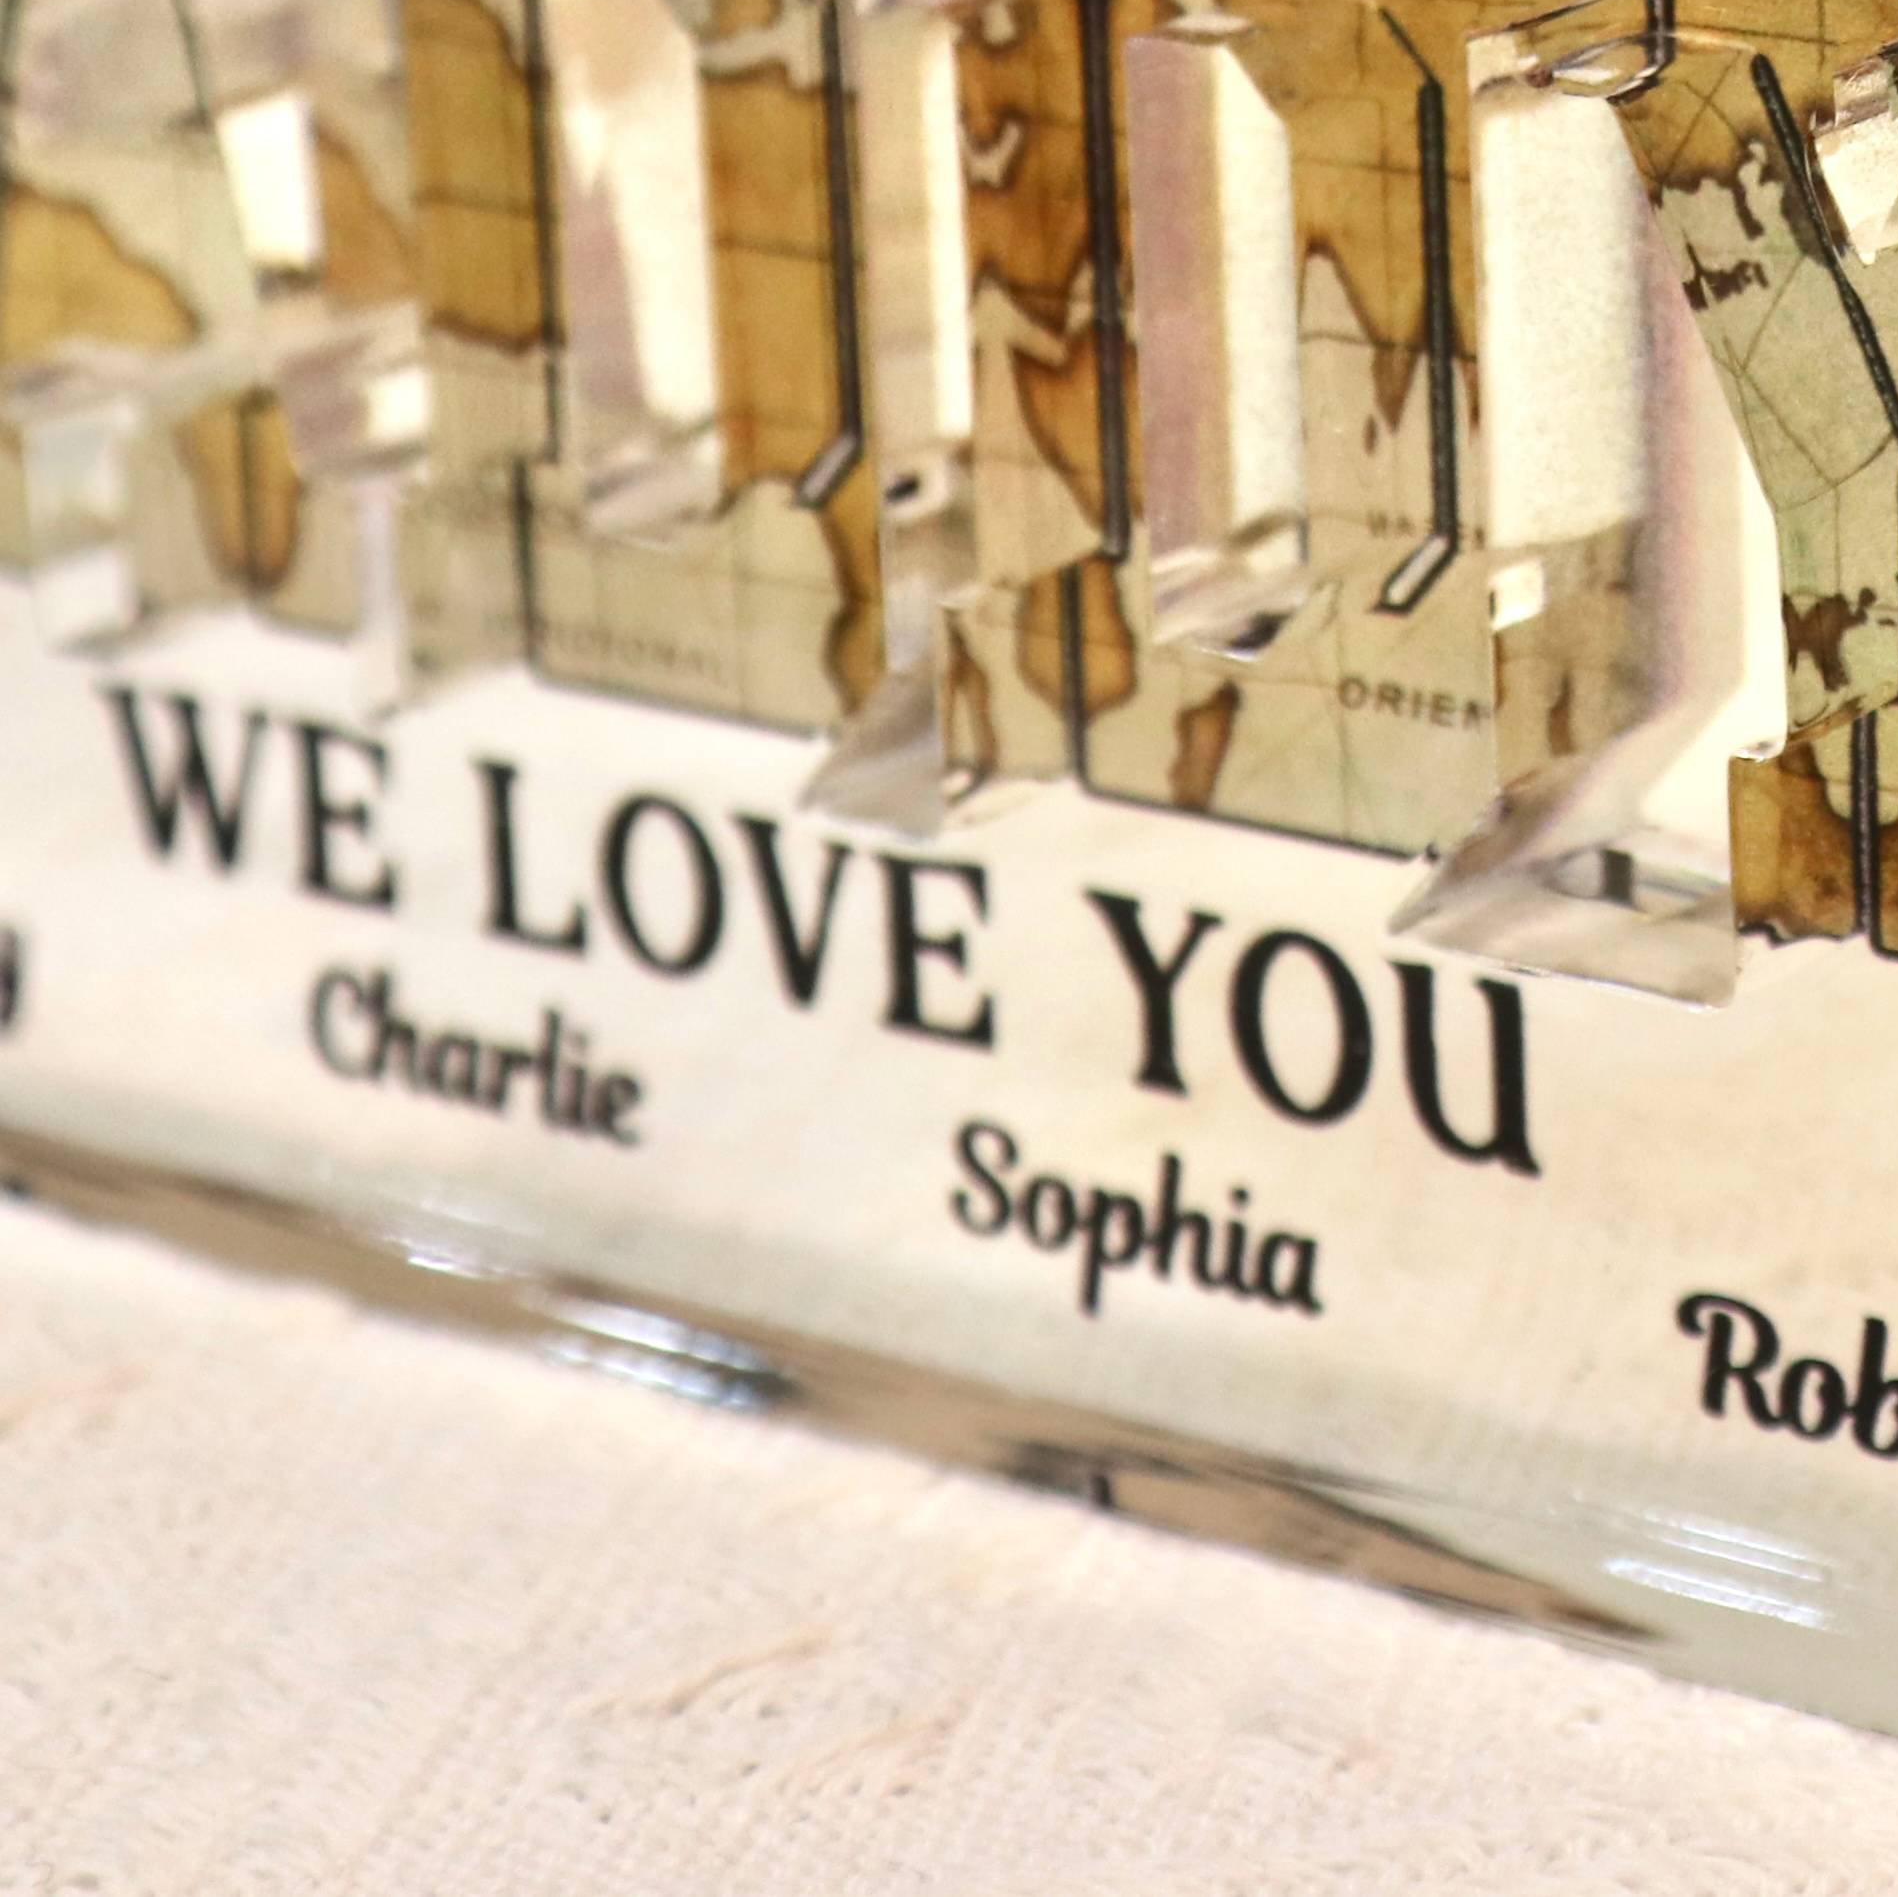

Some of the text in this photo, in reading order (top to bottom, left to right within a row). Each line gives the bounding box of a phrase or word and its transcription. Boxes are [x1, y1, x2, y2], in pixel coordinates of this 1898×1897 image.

[100, 678, 1543, 1178] WE LOVE YOU
[308, 965, 648, 1149] Charlie
[949, 1118, 1323, 1315] Sophia
